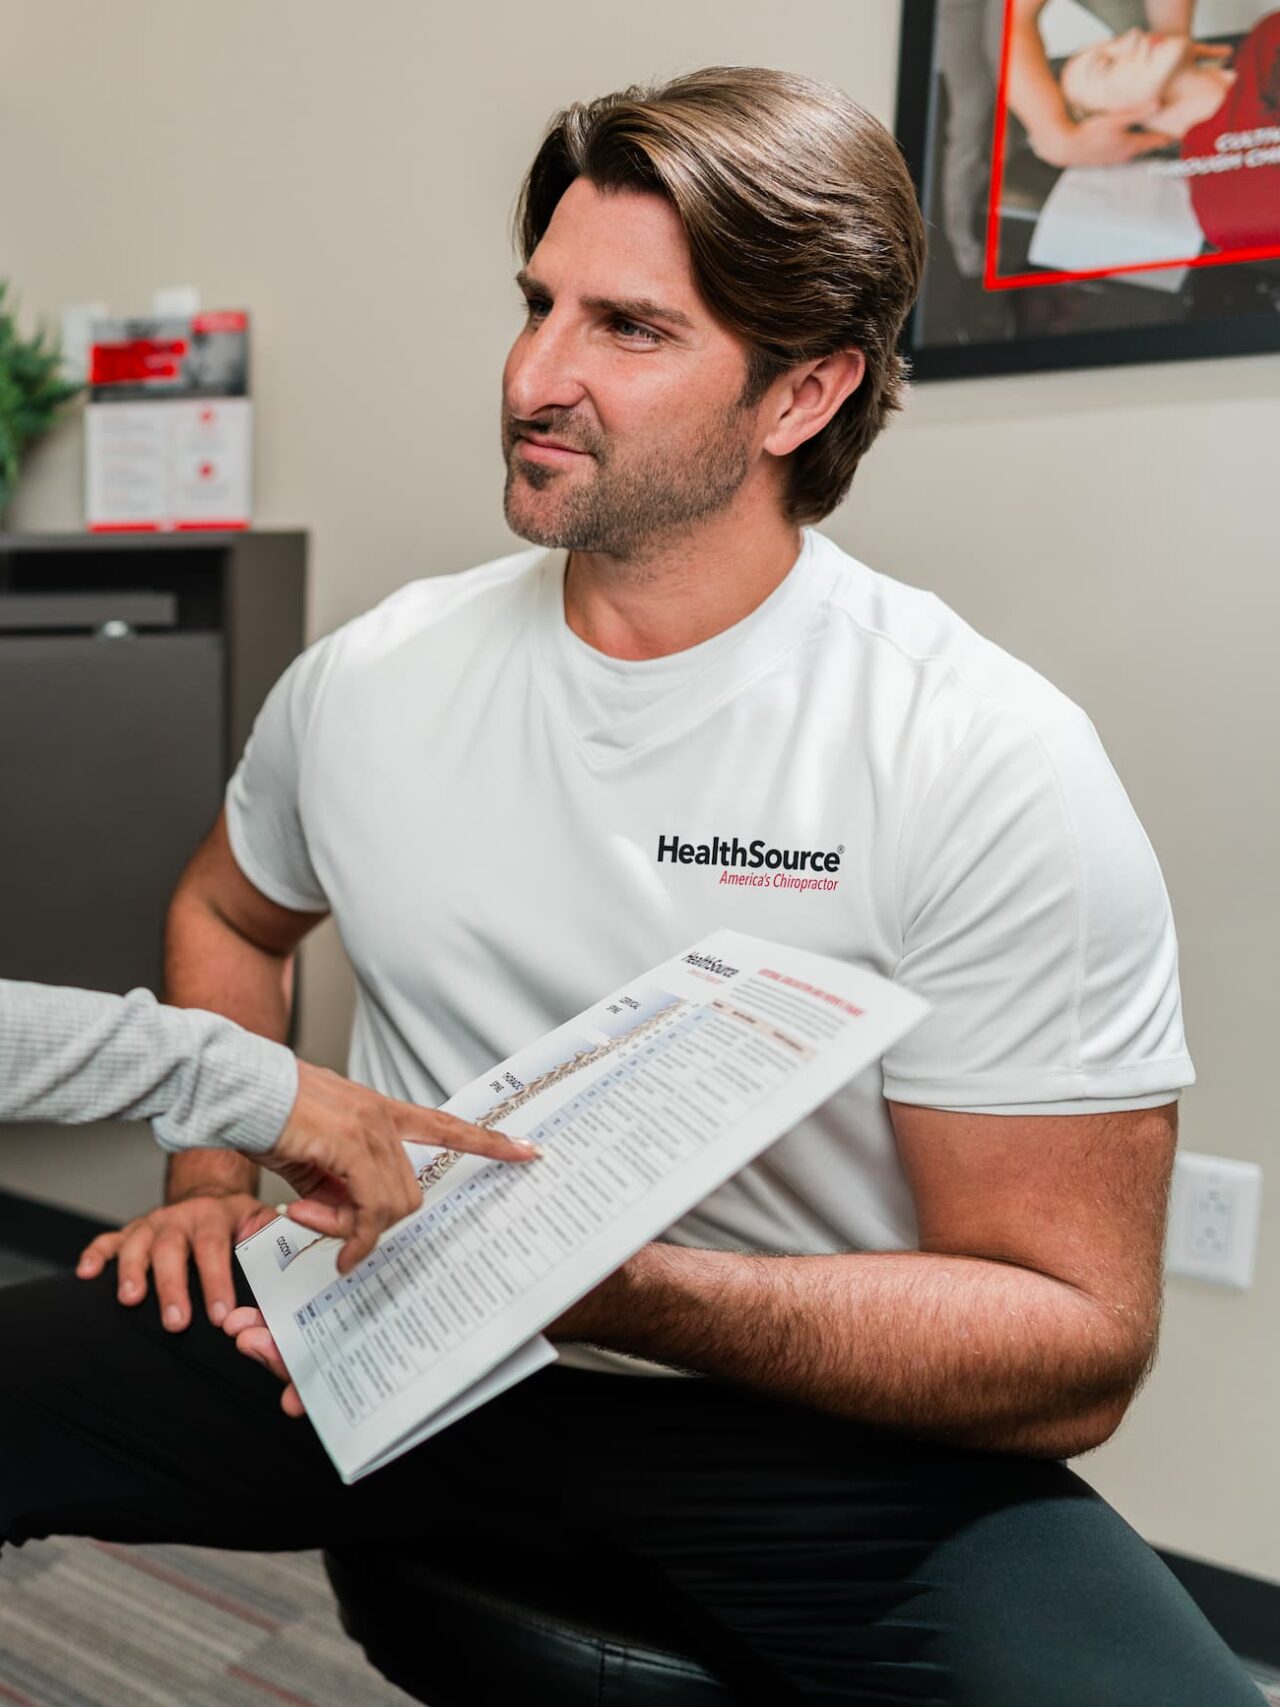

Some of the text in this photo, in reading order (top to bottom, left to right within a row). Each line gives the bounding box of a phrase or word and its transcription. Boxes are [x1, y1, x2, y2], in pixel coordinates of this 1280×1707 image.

[719, 870, 839, 893] America's Chiropractor
[681, 951, 739, 978] HealthSource
[276, 1235, 292, 1258] COCCYX
